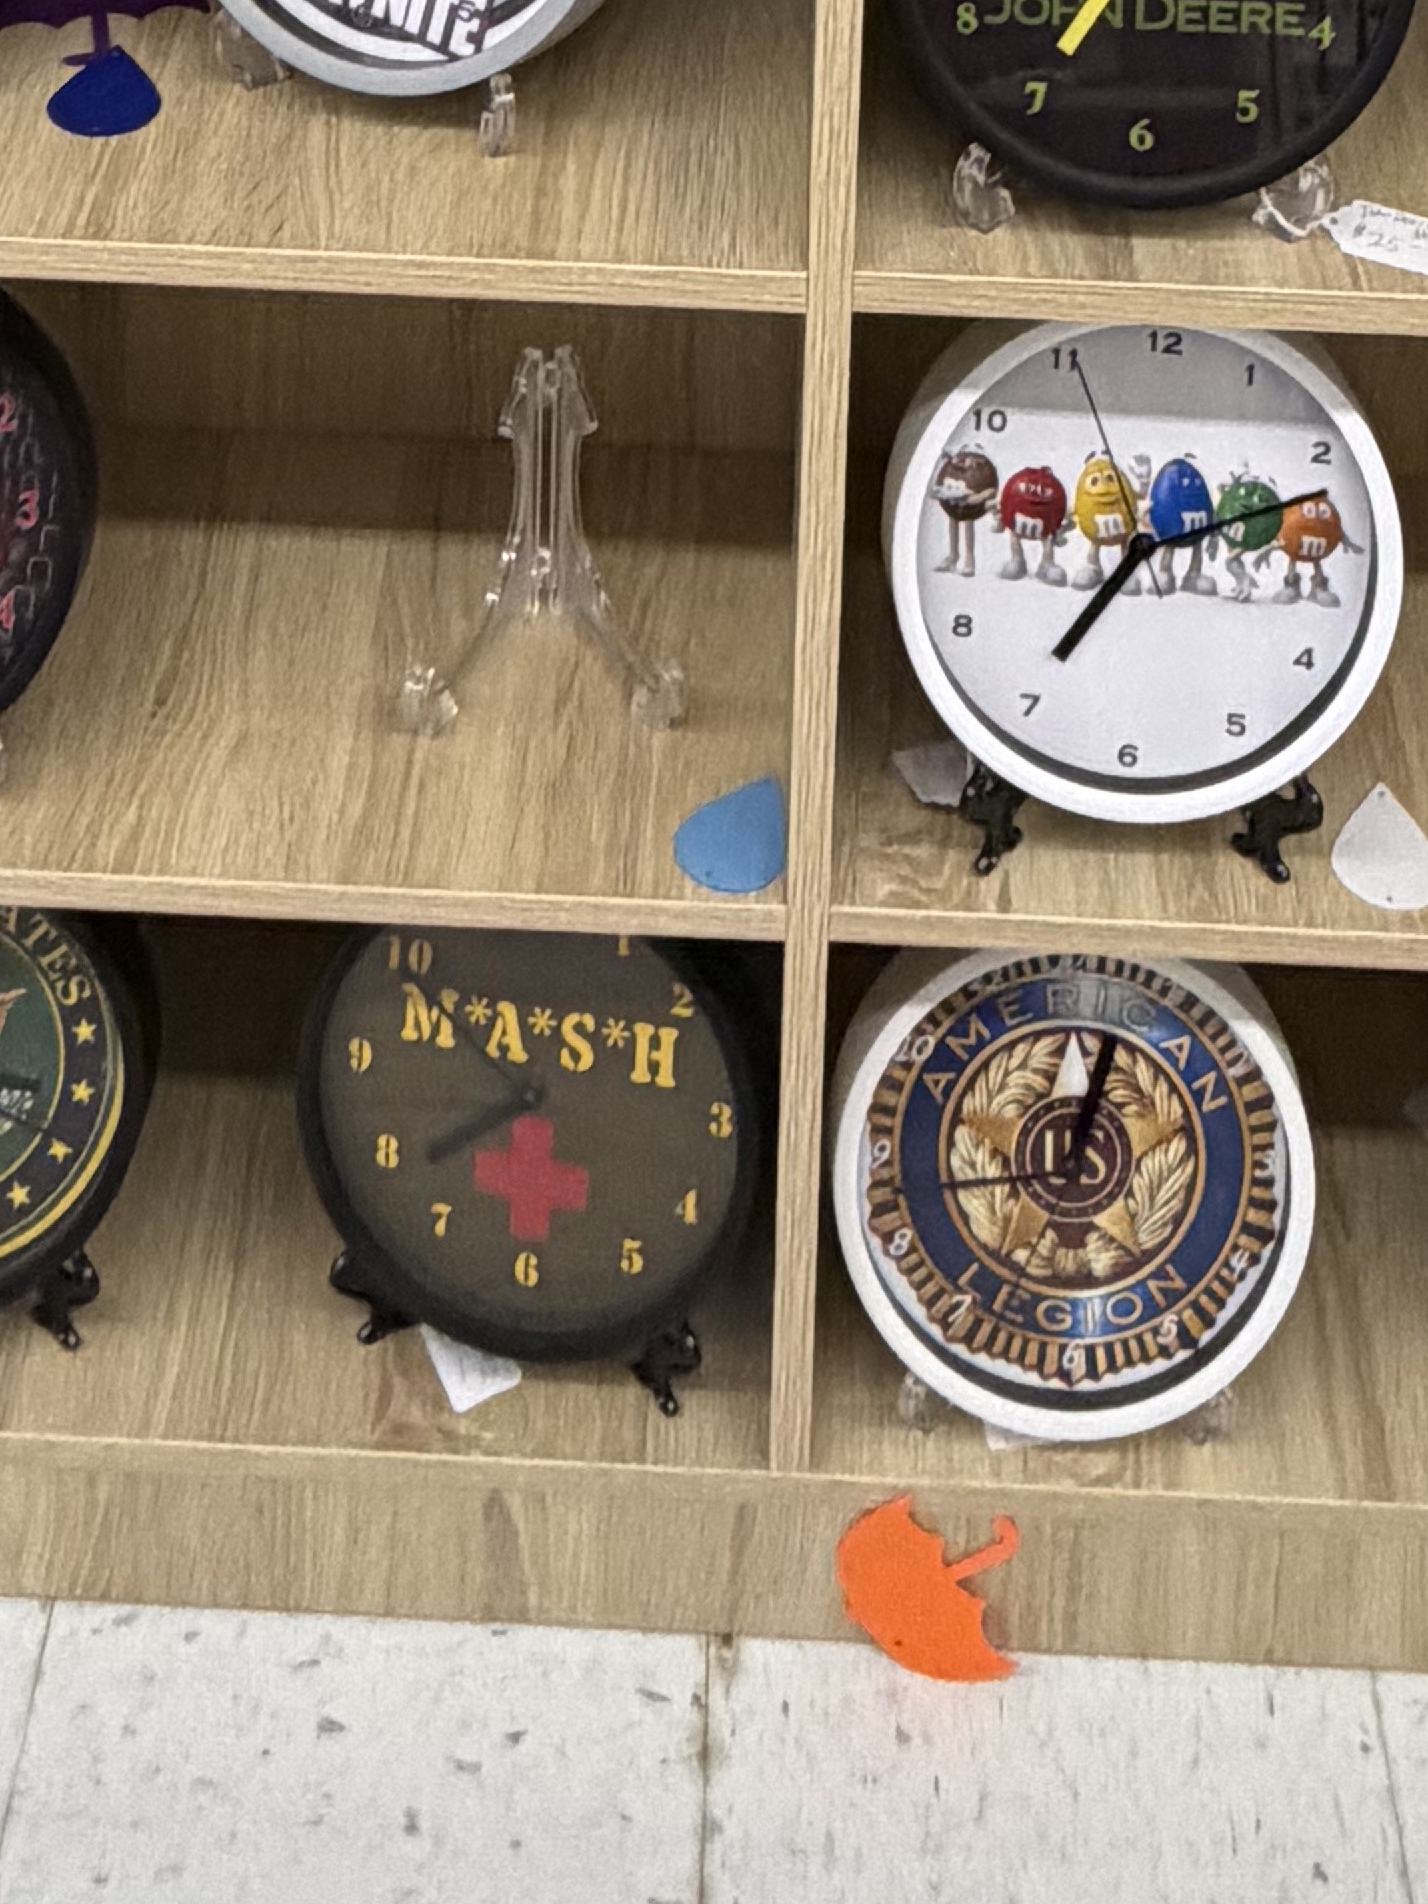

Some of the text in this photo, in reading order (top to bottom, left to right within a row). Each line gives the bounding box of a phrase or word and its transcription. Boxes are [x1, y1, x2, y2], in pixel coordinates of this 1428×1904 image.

[956, 4, 979, 34] 8
[1024, 82, 1048, 114] 7
[1236, 91, 1260, 123] 5
[1128, 119, 1155, 151] 6
[1148, 330, 1183, 355] 12
[1245, 364, 1255, 385] 1
[972, 410, 1007, 433] 10
[1311, 442, 1332, 464] 2
[952, 615, 973, 637] 8
[1293, 647, 1316, 669] 4
[1019, 693, 1041, 716] 7
[1226, 713, 1247, 736] 5
[1118, 745, 1138, 766] 6
[670, 983, 695, 1017] 2
[349, 1038, 372, 1072] 9
[922, 980, 1229, 1114] AMERICAN
[709, 1102, 732, 1137] 3
[376, 1135, 399, 1168] 8
[430, 1203, 451, 1237] 7
[514, 1252, 539, 1287] 6
[621, 1239, 642, 1274] 5
[957, 1261, 1186, 1333] LEGION
